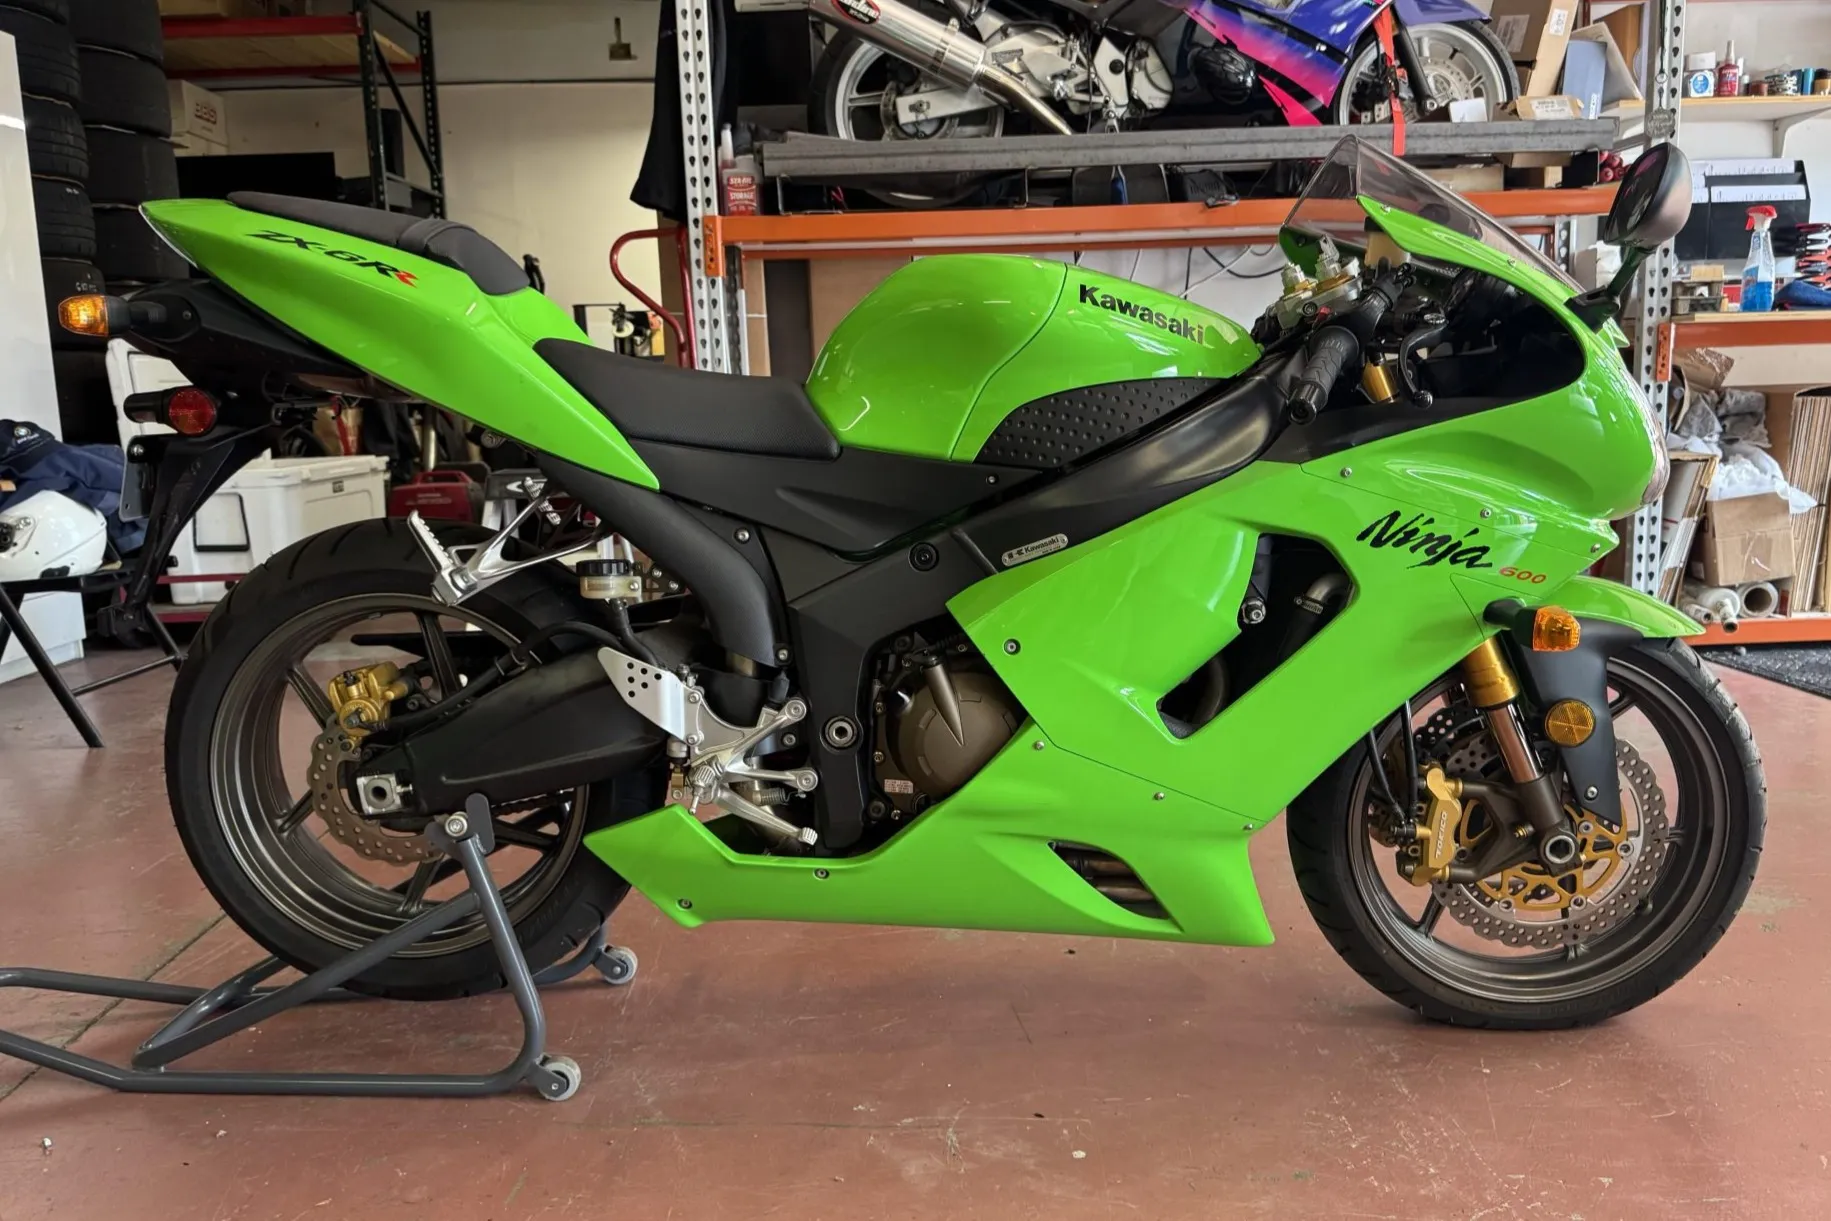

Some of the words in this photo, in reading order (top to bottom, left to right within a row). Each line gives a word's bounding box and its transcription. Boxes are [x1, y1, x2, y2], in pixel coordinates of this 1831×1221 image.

[1079, 284, 1204, 345] Kawasaki
[1024, 536, 1060, 553] Kawasaki
[1356, 510, 1493, 569] Ninja
[1499, 567, 1547, 584] 600
[1435, 811, 1448, 860] TOKICO
